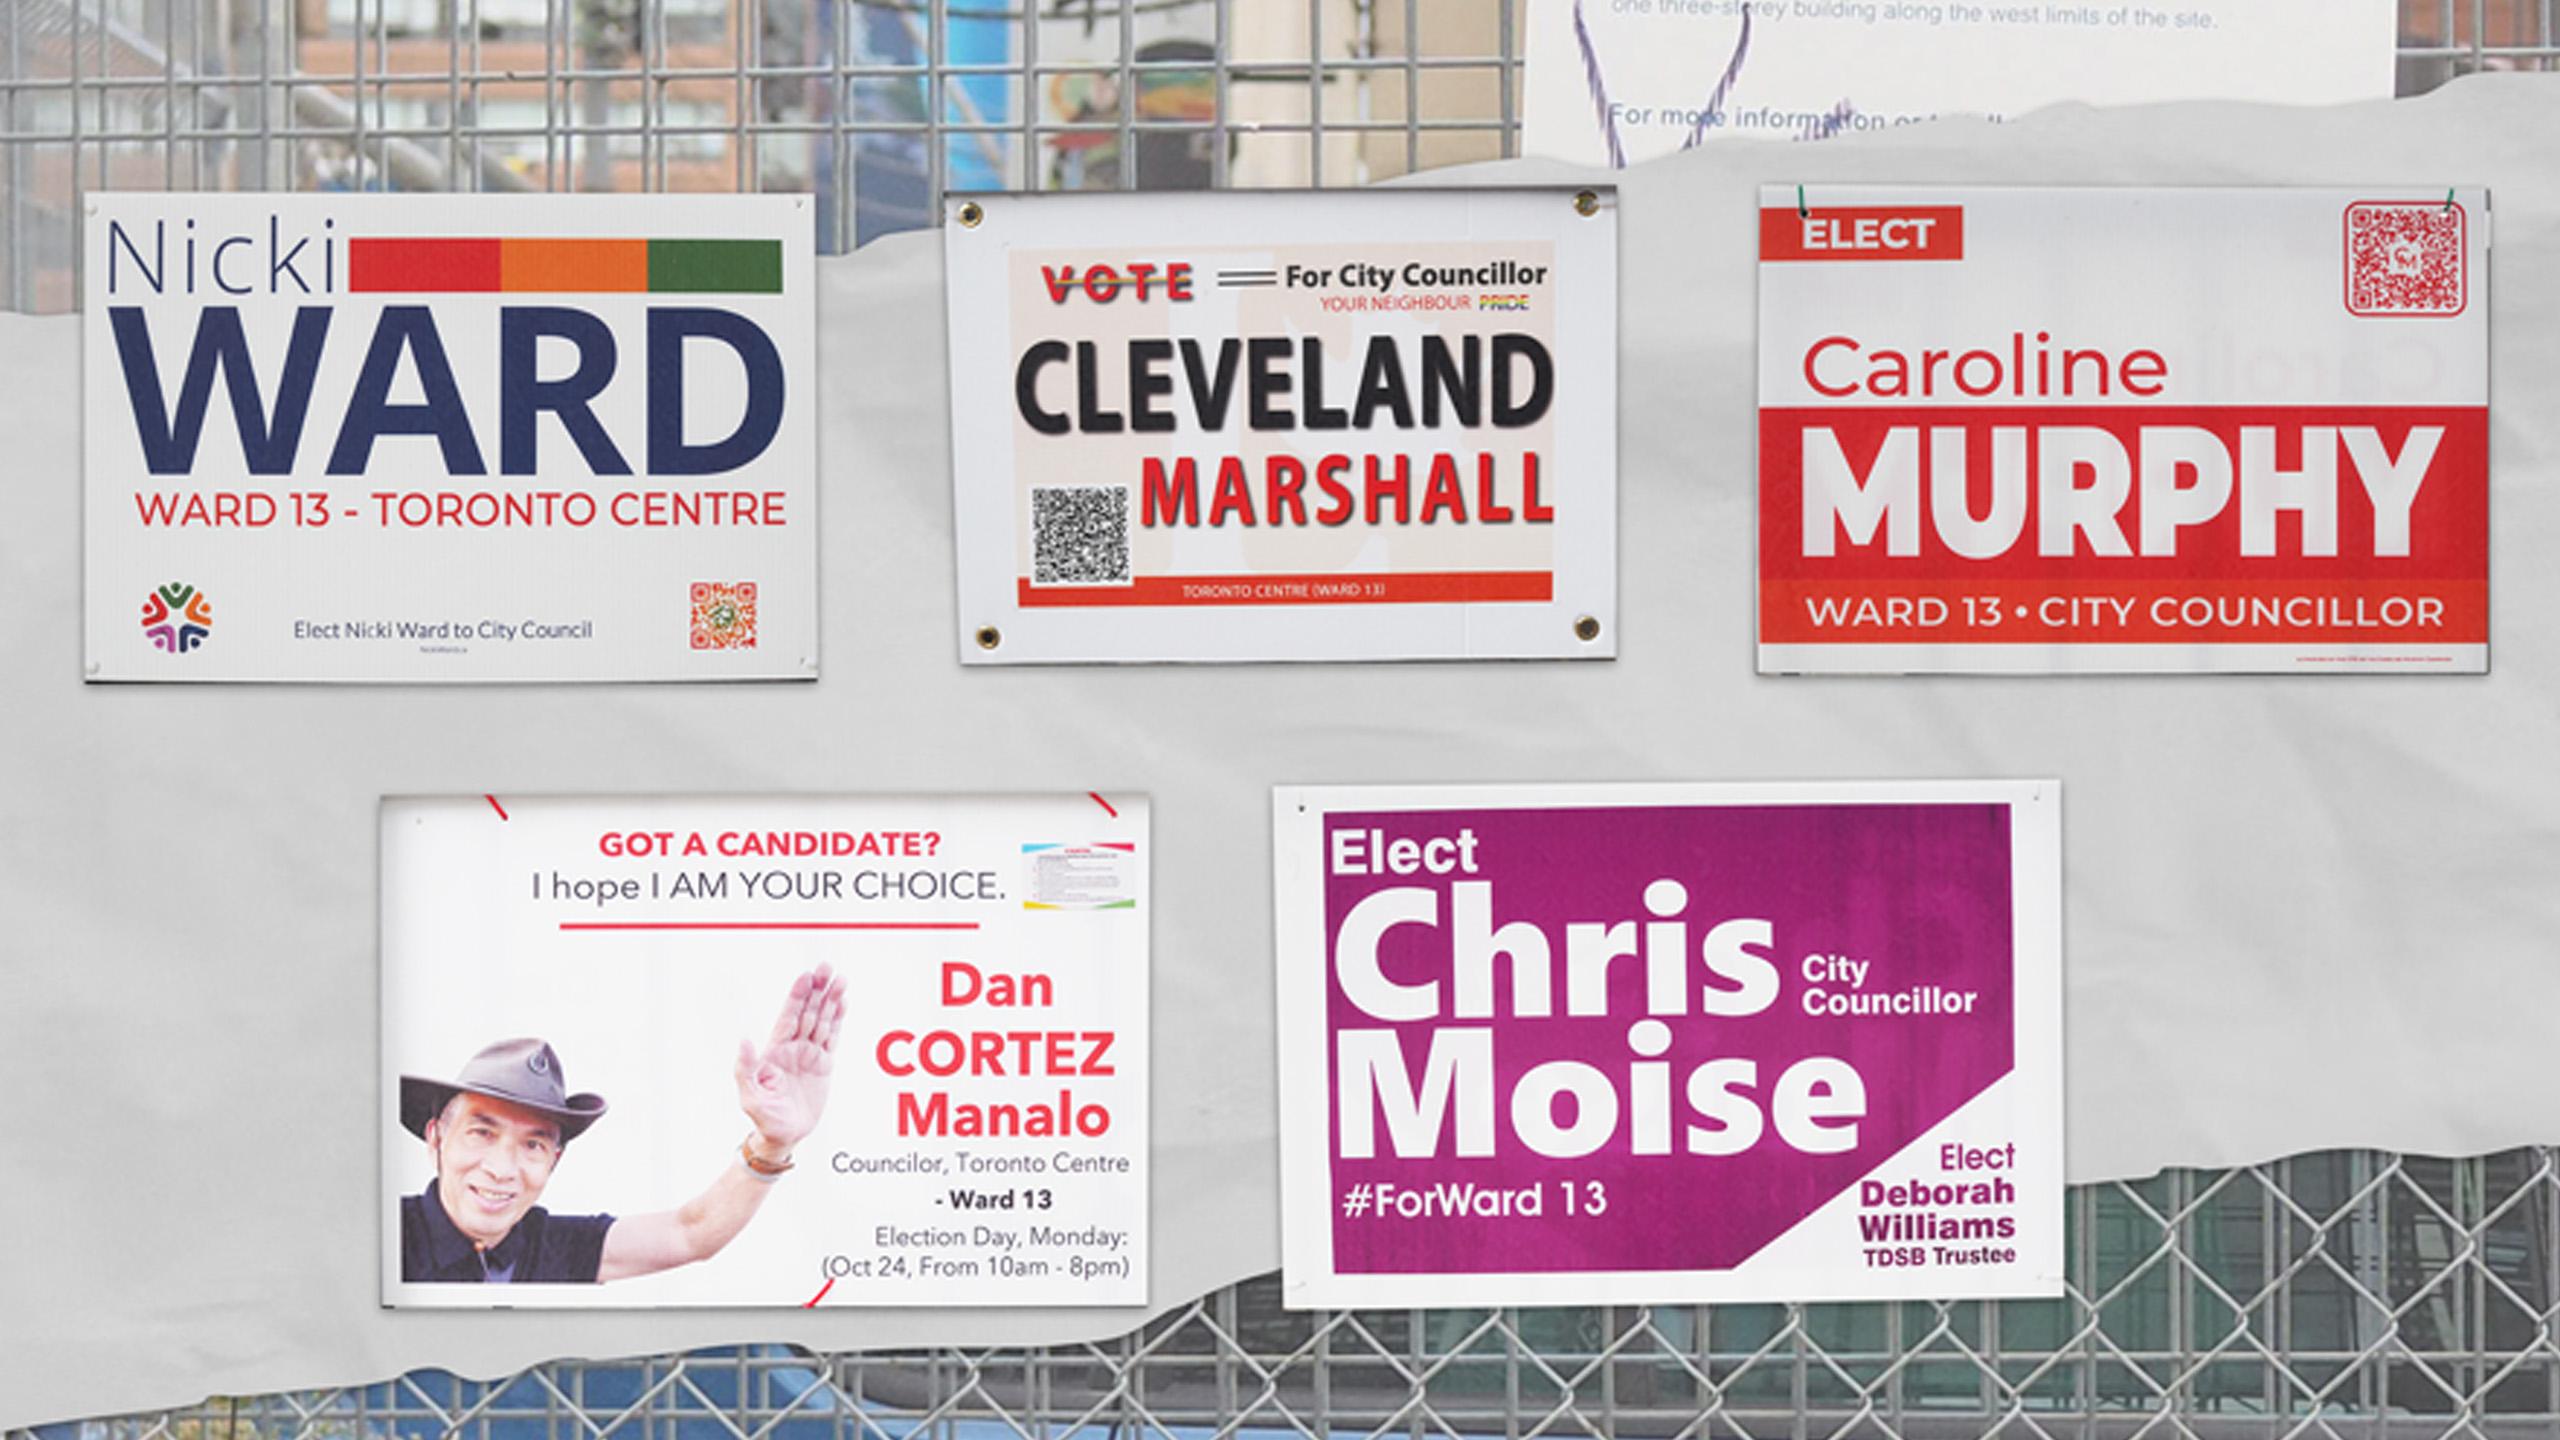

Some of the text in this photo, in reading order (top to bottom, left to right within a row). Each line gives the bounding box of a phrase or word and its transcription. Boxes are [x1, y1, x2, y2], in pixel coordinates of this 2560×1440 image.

[1611, 0, 2219, 29] one three-strey building along the west limits of the site.
[1608, 103, 1651, 125] For
[1800, 216, 1936, 249] ELECT
[109, 215, 333, 294] Nicki
[1042, 263, 1193, 304] VOTE
[1287, 261, 1547, 293] For City Councillor
[1320, 292, 1529, 312] YOUR NEIGHBOUR PRIDE
[1804, 332, 2167, 397] Caroline
[108, 305, 785, 475] WARD
[1016, 333, 1554, 436] CLEVELAND
[1141, 452, 1553, 528] MARSHALL
[1802, 426, 2445, 559] MURPHY
[135, 493, 276, 526] WARD
[290, 493, 329, 527] 13
[372, 493, 596, 526] TORONTO
[611, 492, 786, 526] CENTRE
[1183, 583, 1385, 598] TORONTO CENTRE (WARD 13)
[1806, 597, 2443, 626] WARD 13 CITY COUNCILLOR
[295, 620, 592, 641] Elect Nicki Ward to City Council
[600, 832, 940, 857] GOT A CANDIDATE?
[1332, 829, 1478, 874] Elect
[533, 873, 539, 899] I
[553, 872, 640, 906] hope
[652, 873, 658, 898] I
[670, 872, 727, 898] AM
[739, 871, 842, 899] YOUR
[853, 871, 1005, 899] CHOICE.
[1335, 879, 1779, 1021] Chris
[942, 962, 1052, 1006] Dan
[1802, 955, 1869, 988] City
[1803, 985, 1977, 1015] Councillor
[876, 1030, 1114, 1076] CORTEZ
[1337, 1017, 1866, 1158] Moise
[898, 1089, 1110, 1137] Manalo
[832, 1152, 1129, 1175] Councilor, Toronto Centre
[1941, 1143, 2015, 1170] Elect
[950, 1189, 1014, 1209] Ward
[1024, 1189, 1052, 1210] 13
[1343, 1181, 1606, 1217] #ForWard 13
[1858, 1176, 2014, 1207] Deborah
[876, 1226, 1127, 1251] Election Day, Monday:
[1859, 1213, 2015, 1241] Williams
[822, 1256, 871, 1281] (Oct
[879, 1256, 912, 1278] 24,
[920, 1256, 978, 1277] From
[989, 1256, 1048, 1277] 10am
[1070, 1256, 1129, 1280] 8pm)
[1863, 1247, 2015, 1267] TDSB Trustee
